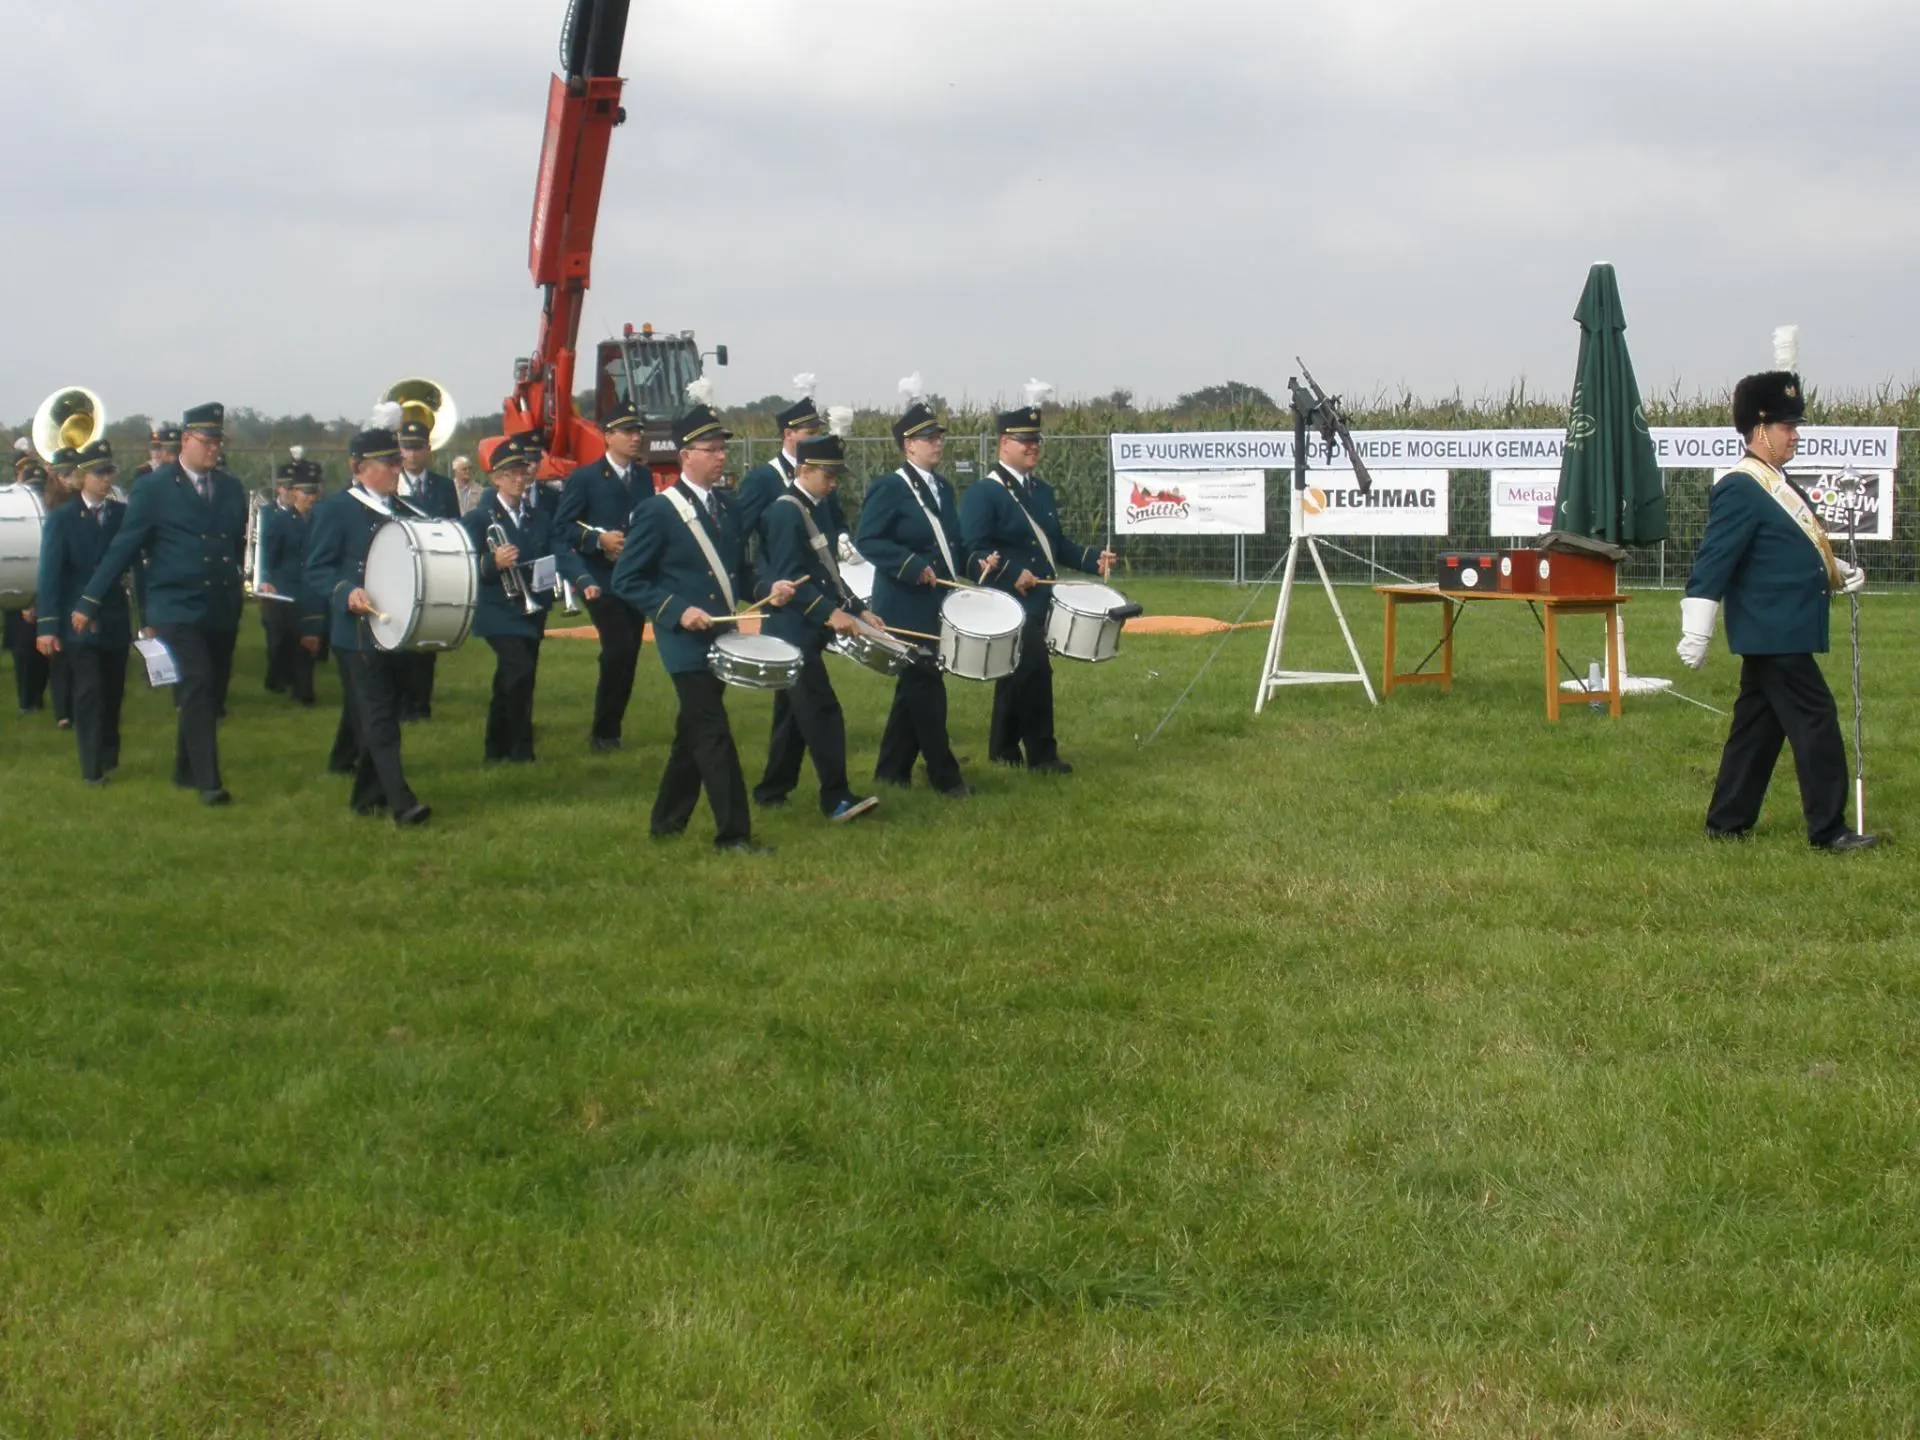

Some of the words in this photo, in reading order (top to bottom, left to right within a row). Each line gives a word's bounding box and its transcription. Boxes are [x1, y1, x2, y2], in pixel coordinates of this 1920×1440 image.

[650, 440, 677, 451] MAN
[1120, 443, 1142, 459] DE
[1146, 441, 1286, 459] VUURWERKSHOW
[1291, 441, 1350, 458] ORD
[1356, 441, 1402, 458] MEDE
[1407, 440, 1493, 458] MOGELIJK
[1495, 440, 1564, 458] GEMAA
[1674, 439, 1748, 457] VOLGEN
[1795, 438, 1887, 457] EDRIJVEN
[1815, 474, 1867, 495] ALS
[1323, 488, 1436, 508] TECHMAG
